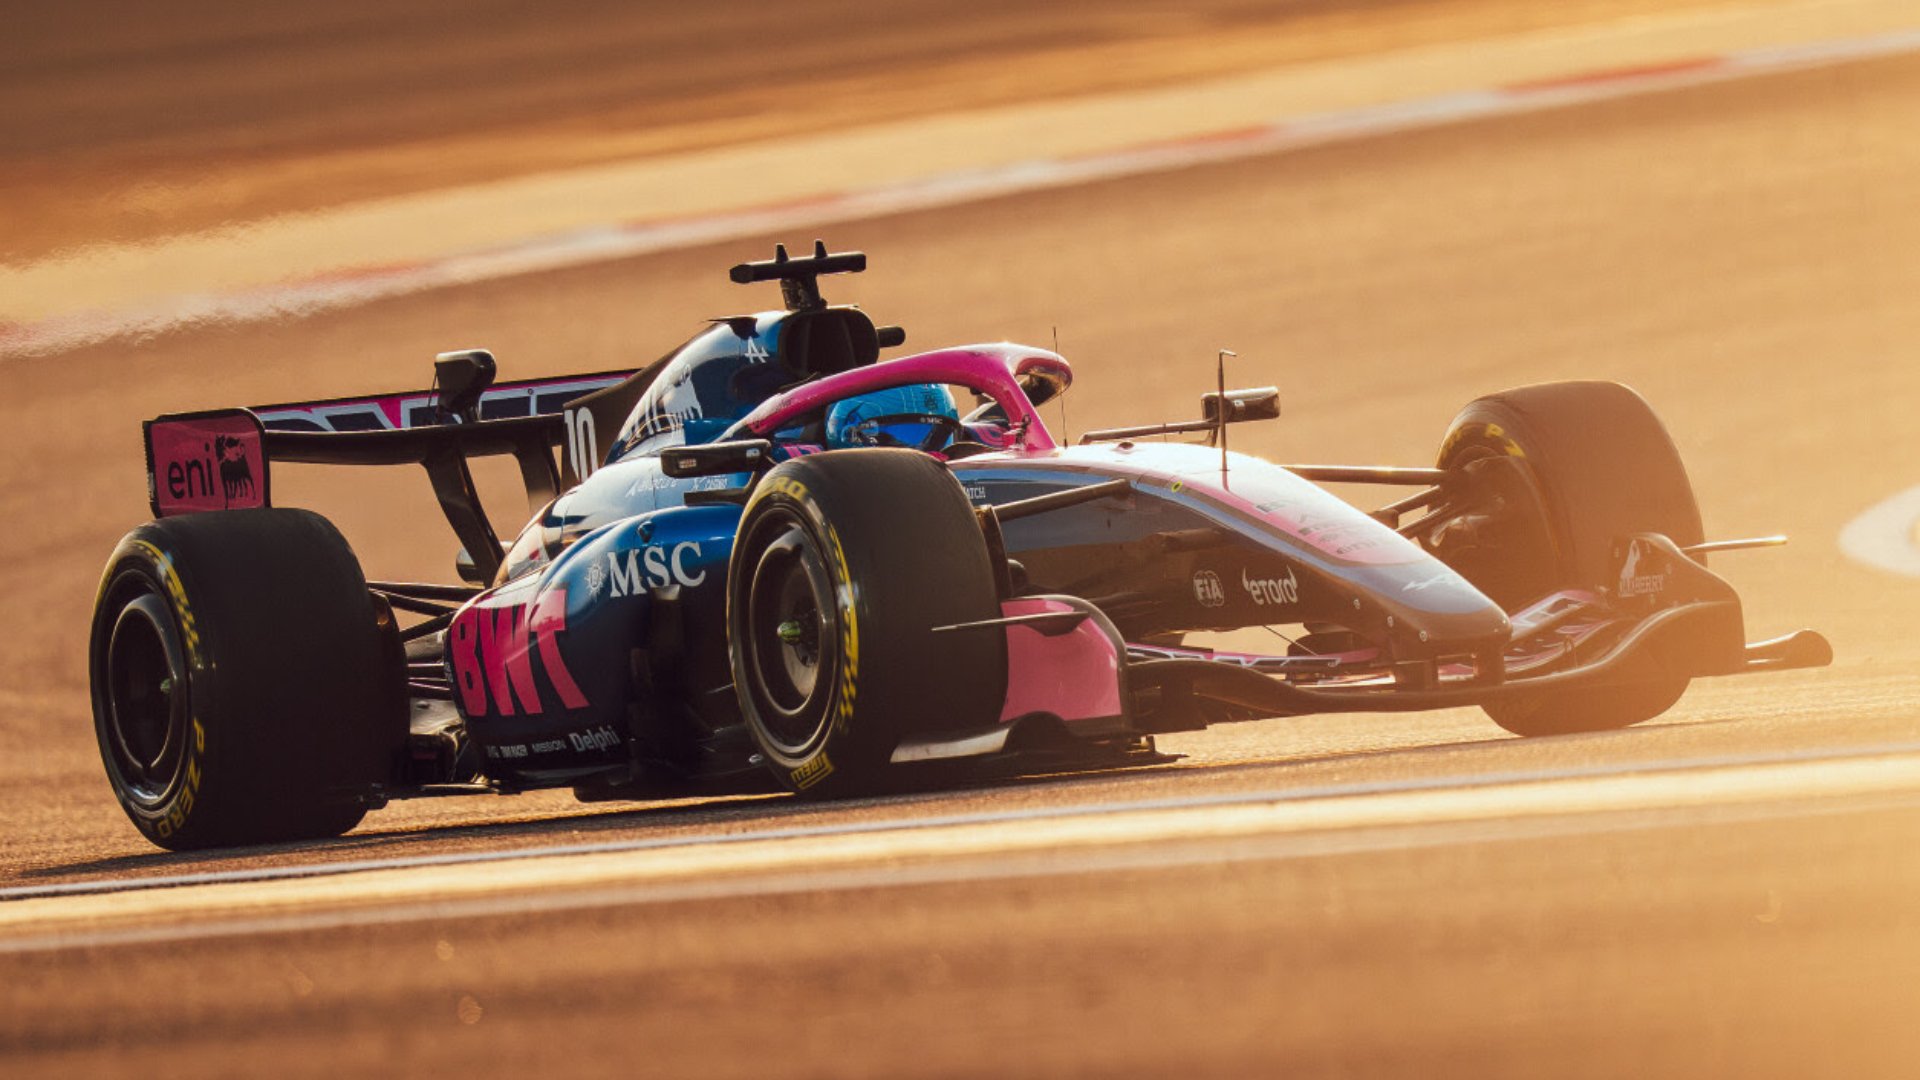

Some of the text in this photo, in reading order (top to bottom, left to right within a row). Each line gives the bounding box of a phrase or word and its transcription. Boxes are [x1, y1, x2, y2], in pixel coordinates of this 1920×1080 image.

[166, 441, 215, 500] eni
[563, 406, 599, 482] 10
[964, 486, 986, 500] ATCH
[607, 541, 707, 598] MSC
[450, 588, 591, 717] BWT
[568, 724, 621, 753] Delphi
